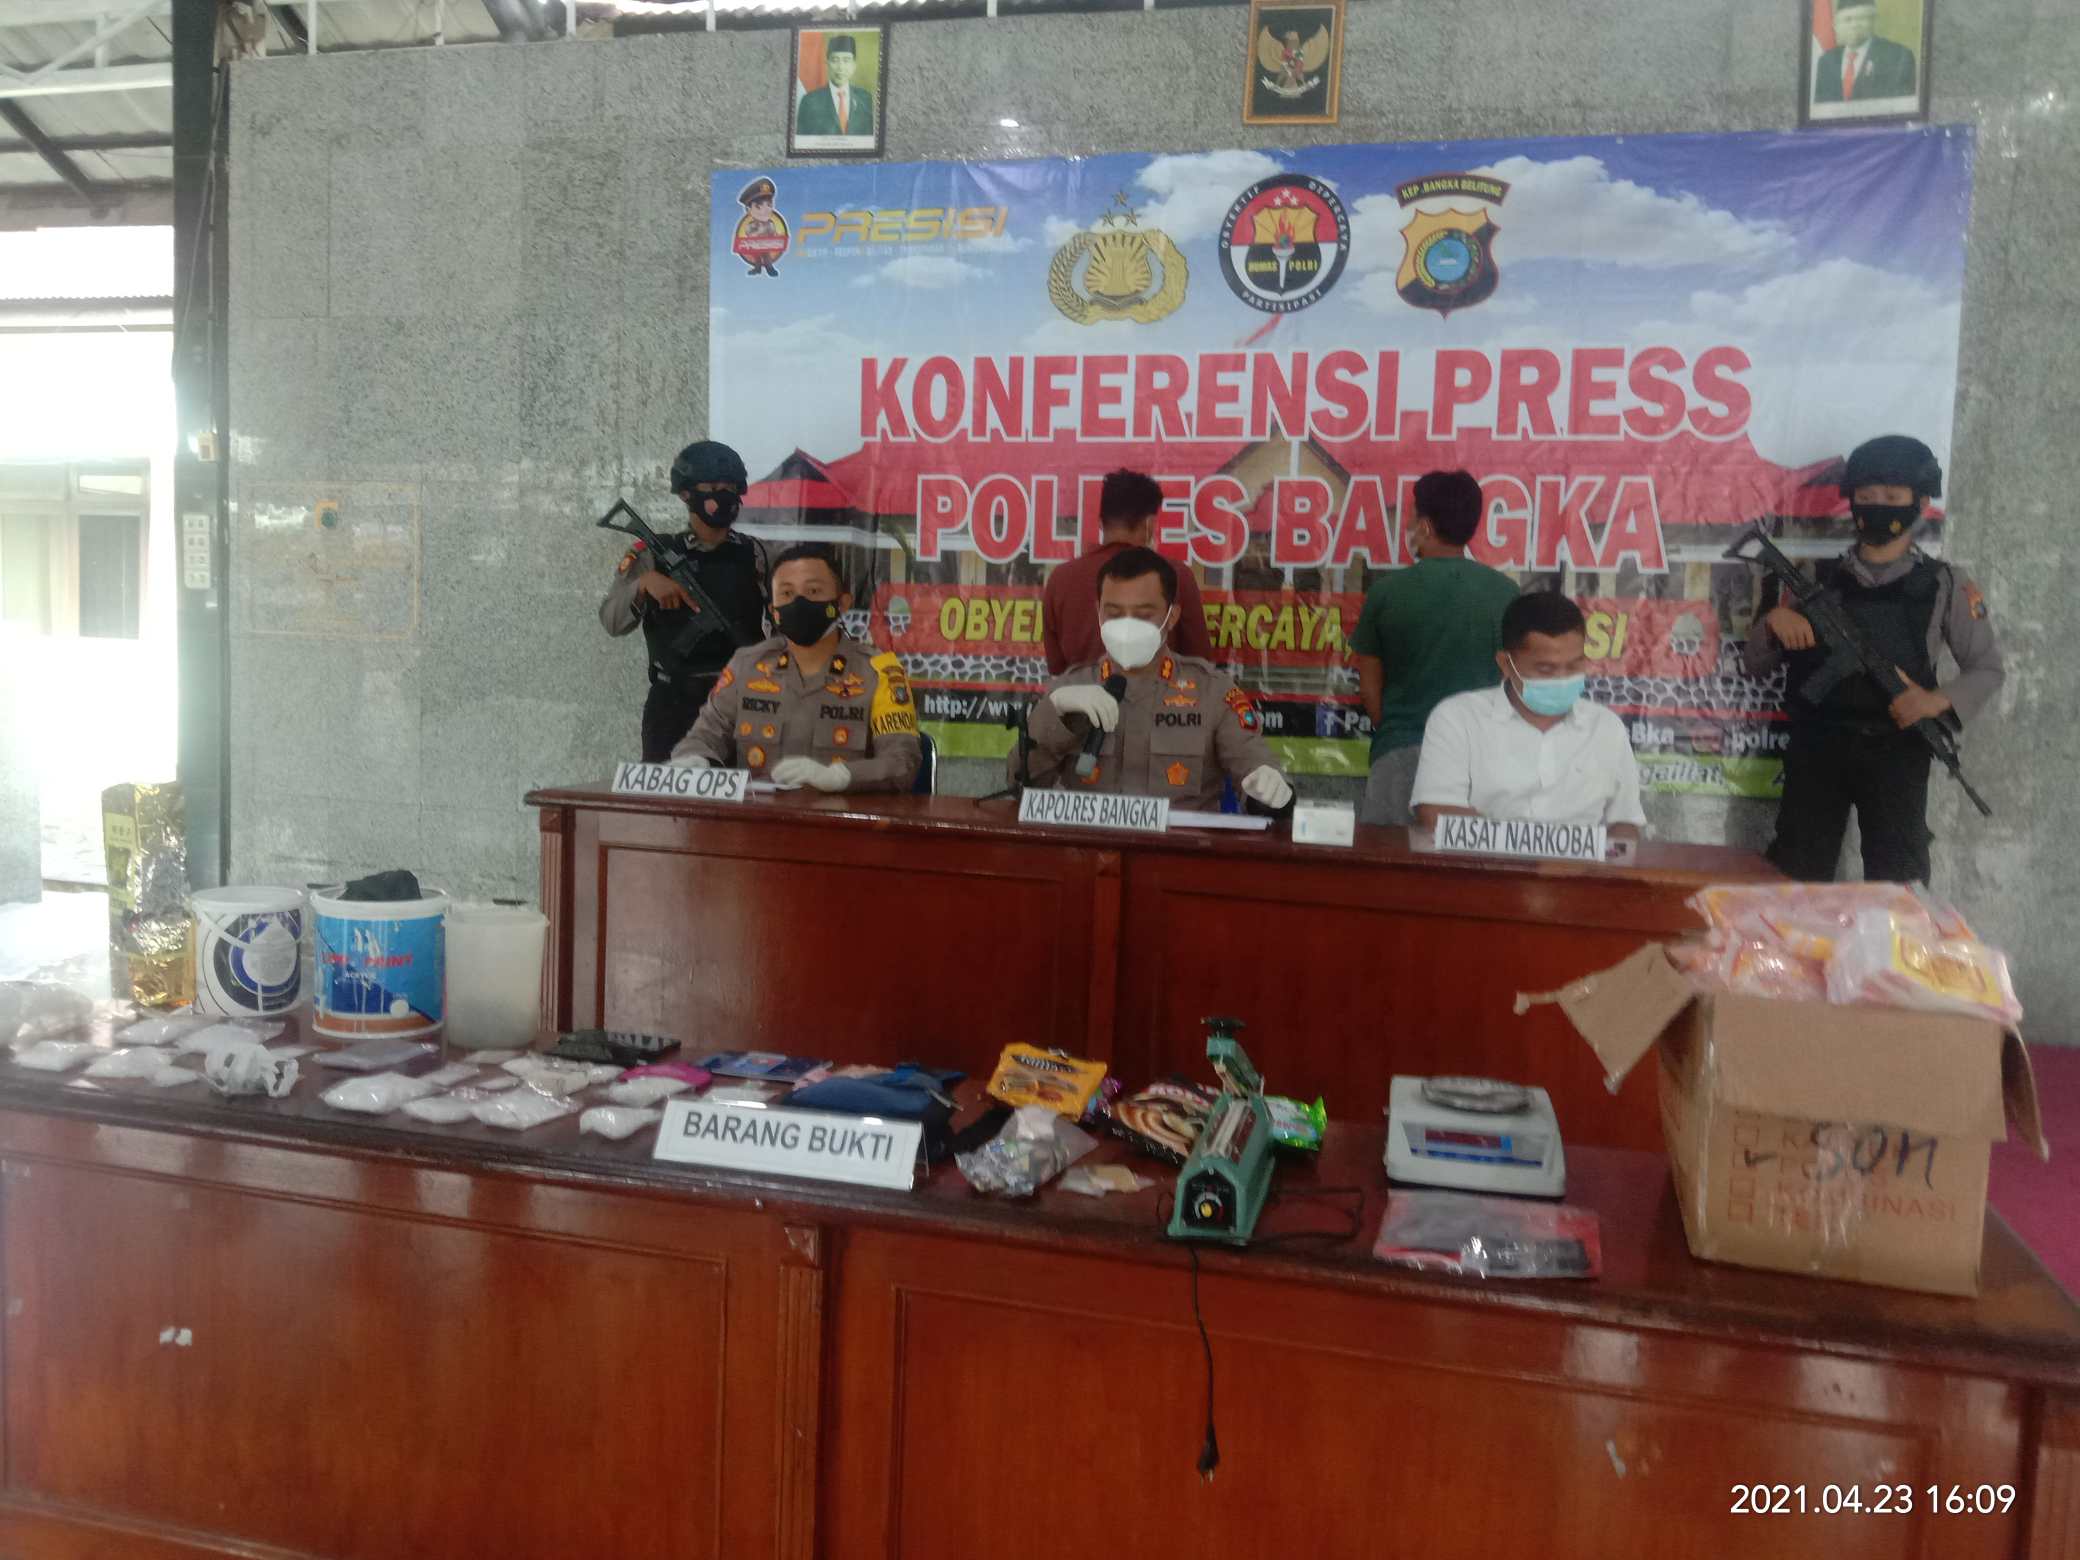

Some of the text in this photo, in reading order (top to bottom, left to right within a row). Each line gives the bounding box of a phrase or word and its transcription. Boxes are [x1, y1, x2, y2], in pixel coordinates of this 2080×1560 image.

[796, 206, 1009, 246] PRESISI
[859, 343, 1755, 444] KONFERENSI PRESS
[1270, 474, 1670, 574] BAGKA
[820, 704, 865, 722] POLRI
[1155, 712, 1202, 728] POLRI
[618, 764, 740, 798] KABAG OPS
[1026, 791, 1160, 828] KAPOLRES BANGKA
[1443, 816, 1596, 858] KASAT NARKOBA
[683, 1111, 894, 1162] BARANG BUKTI
